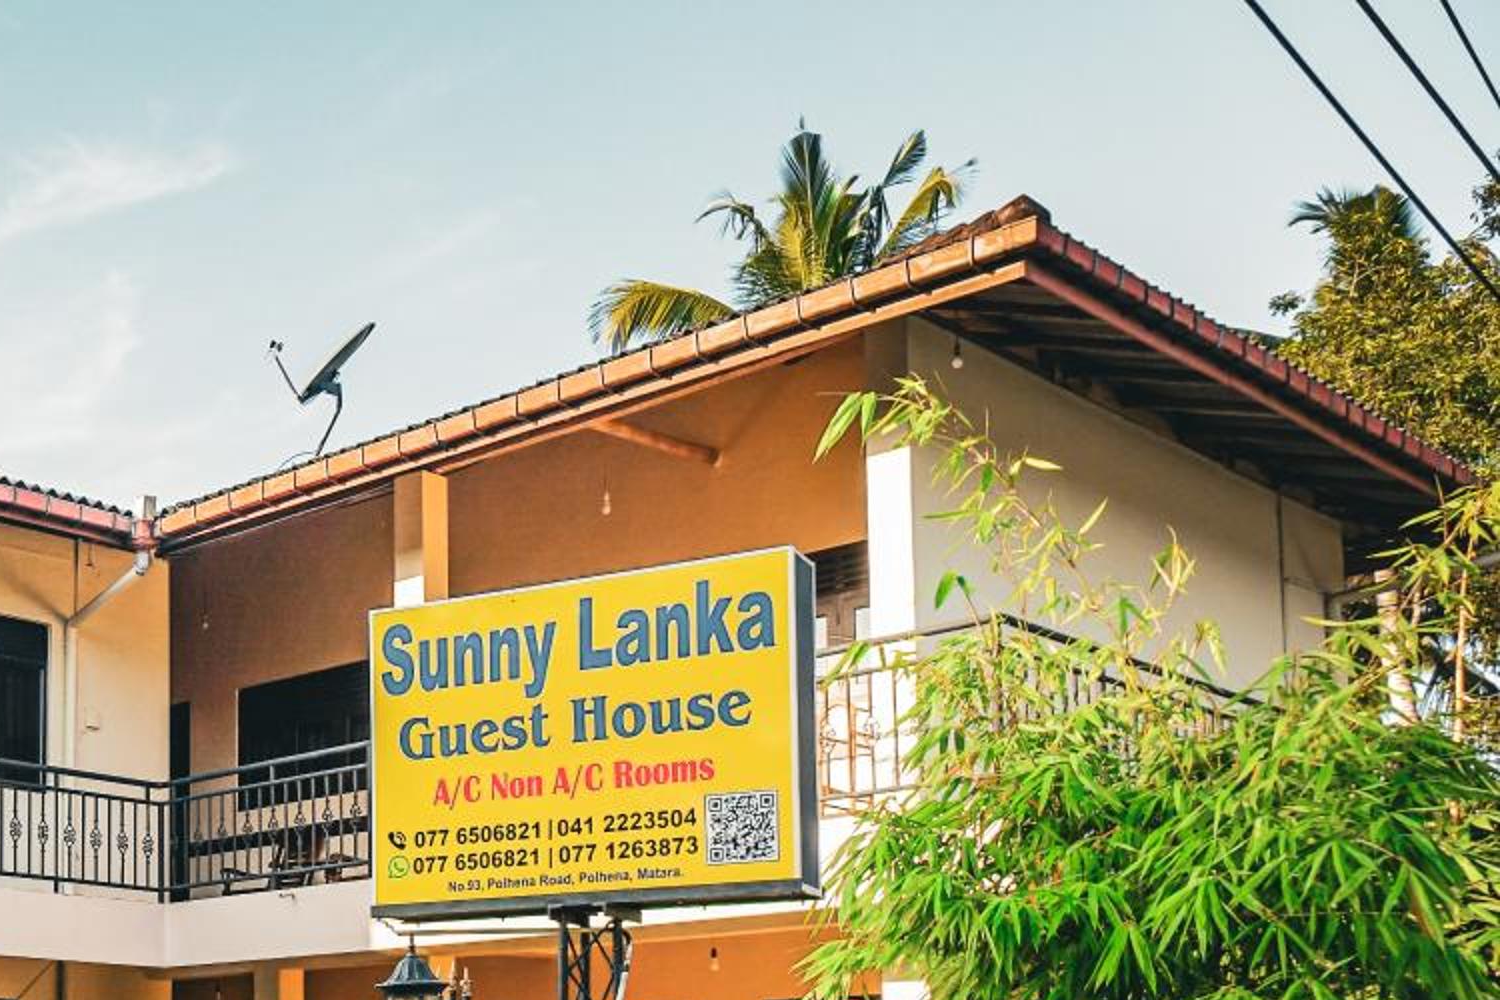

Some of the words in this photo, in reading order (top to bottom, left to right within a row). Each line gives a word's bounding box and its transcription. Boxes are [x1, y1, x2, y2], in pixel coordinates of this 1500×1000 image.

[381, 620, 556, 698] Sunny
[578, 580, 775, 671] Lanka
[399, 702, 551, 761] Guest
[570, 689, 752, 744] House
[433, 777, 481, 811] A/C
[490, 769, 543, 800] Non
[553, 763, 603, 799] A/C
[613, 758, 716, 789] Rooms
[414, 829, 449, 848] 077
[456, 821, 541, 845] 6506821
[557, 816, 594, 837] 041
[603, 808, 697, 833] 2223504
[413, 856, 447, 875] 077
[455, 848, 540, 872] 6506821
[559, 844, 596, 864] 077
[605, 836, 699, 860] 1263873
[487, 876, 536, 890] Polhena
[539, 873, 575, 887] Road,
[579, 869, 633, 884] Polhena,
